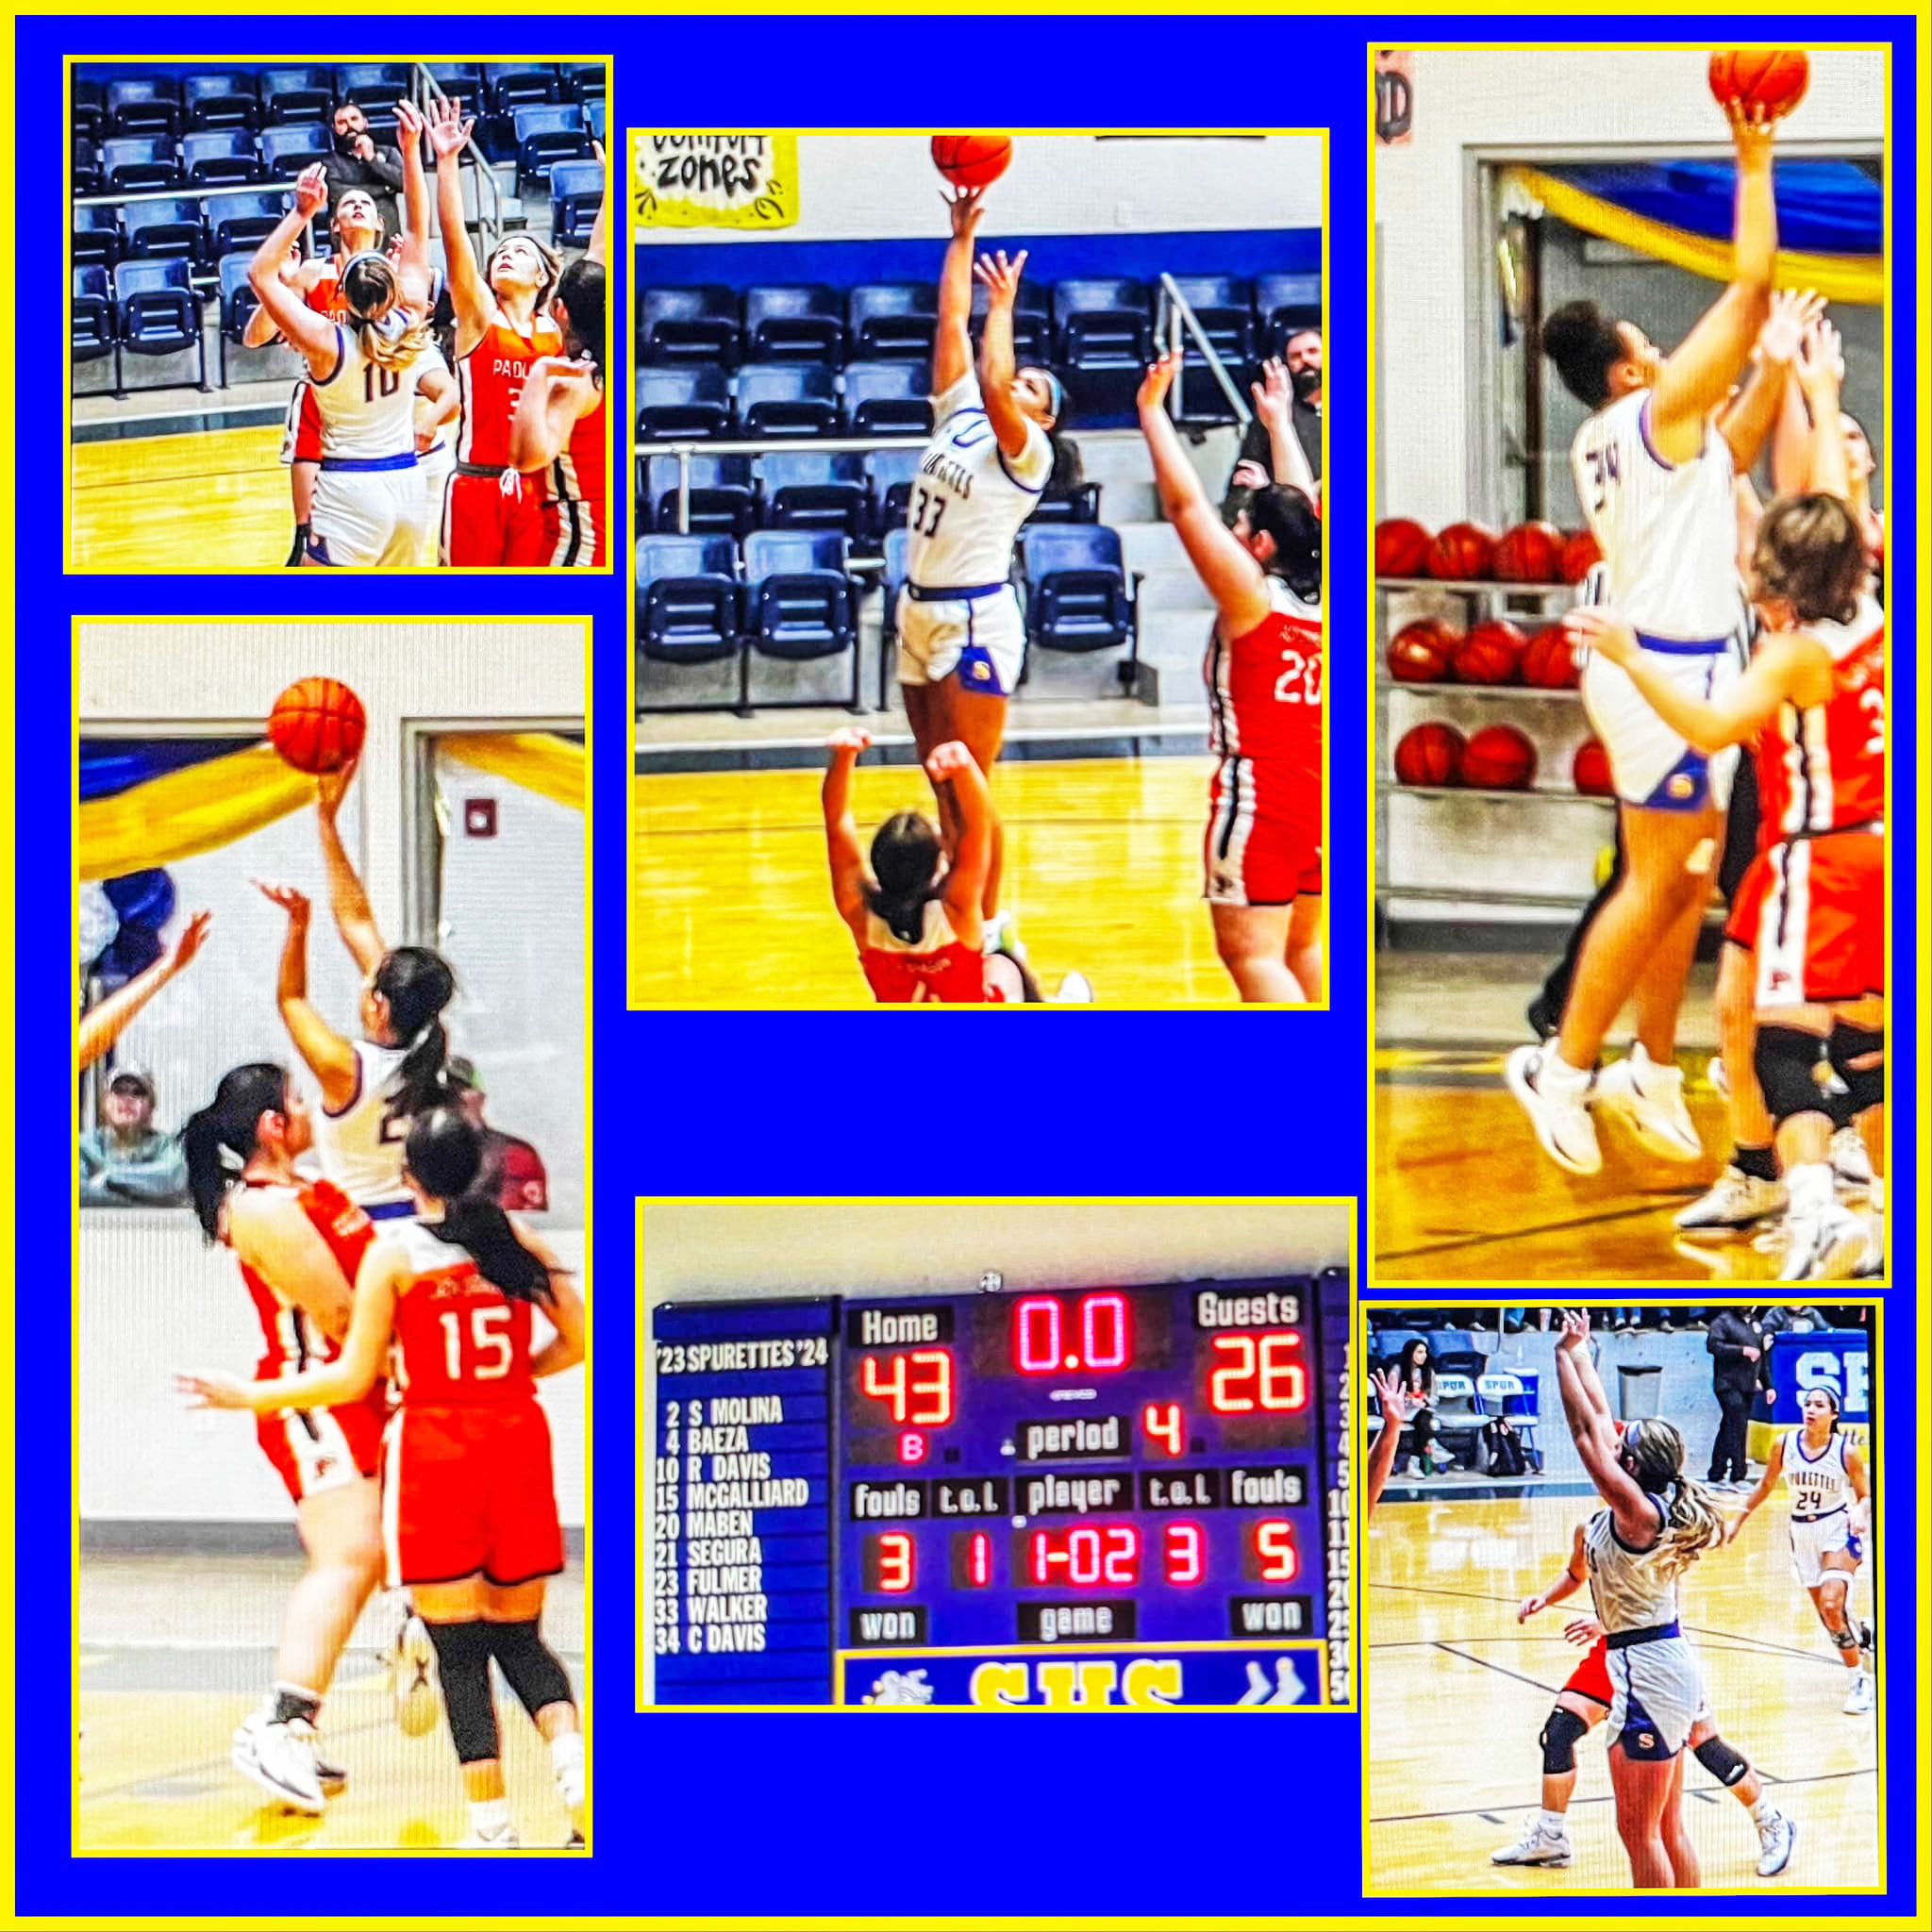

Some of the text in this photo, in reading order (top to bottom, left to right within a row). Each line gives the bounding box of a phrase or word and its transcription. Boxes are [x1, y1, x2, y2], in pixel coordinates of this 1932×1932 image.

[658, 155, 760, 198] zones
[363, 362, 400, 403] 10
[913, 487, 947, 539] 33
[1274, 648, 1322, 706] 20
[861, 1308, 939, 1344] Home
[1197, 1291, 1300, 1327] Guests
[439, 1304, 513, 1381] 15
[1018, 1295, 1125, 1371] 0.0
[686, 1340, 795, 1373] SPURETTES
[795, 1337, 829, 1367] '24
[1211, 1332, 1306, 1410] 26
[862, 1350, 950, 1424] 43
[1484, 1380, 1515, 1391] SPUR
[666, 1395, 784, 1428] 2 S MOLINA
[1145, 1403, 1181, 1455] 4
[665, 1425, 750, 1456] 4 BAEZA
[902, 1434, 924, 1461] B
[1027, 1415, 1119, 1460] period
[656, 1452, 772, 1484] 10 R DAVIS
[656, 1477, 810, 1511] 15 MCGALLIARD
[855, 1482, 921, 1518] fouls
[1027, 1474, 1121, 1516] player
[1231, 1468, 1302, 1505] fouls
[1796, 1491, 1822, 1510] 24
[656, 1509, 754, 1541] 20 MABEN
[656, 1537, 762, 1569] 21 SEGURA
[879, 1534, 911, 1591] 3
[974, 1534, 987, 1584] 1
[1167, 1525, 1200, 1582] 3
[1257, 1522, 1295, 1580] 5
[656, 1565, 762, 1596] 23 FULMER
[656, 1593, 768, 1625] 33 WALKER
[860, 1611, 916, 1641] won
[1041, 1606, 1113, 1642] game
[1241, 1601, 1302, 1631] won
[656, 1623, 767, 1655] 34 C DAVIS
[1638, 1733, 1656, 1750] S
